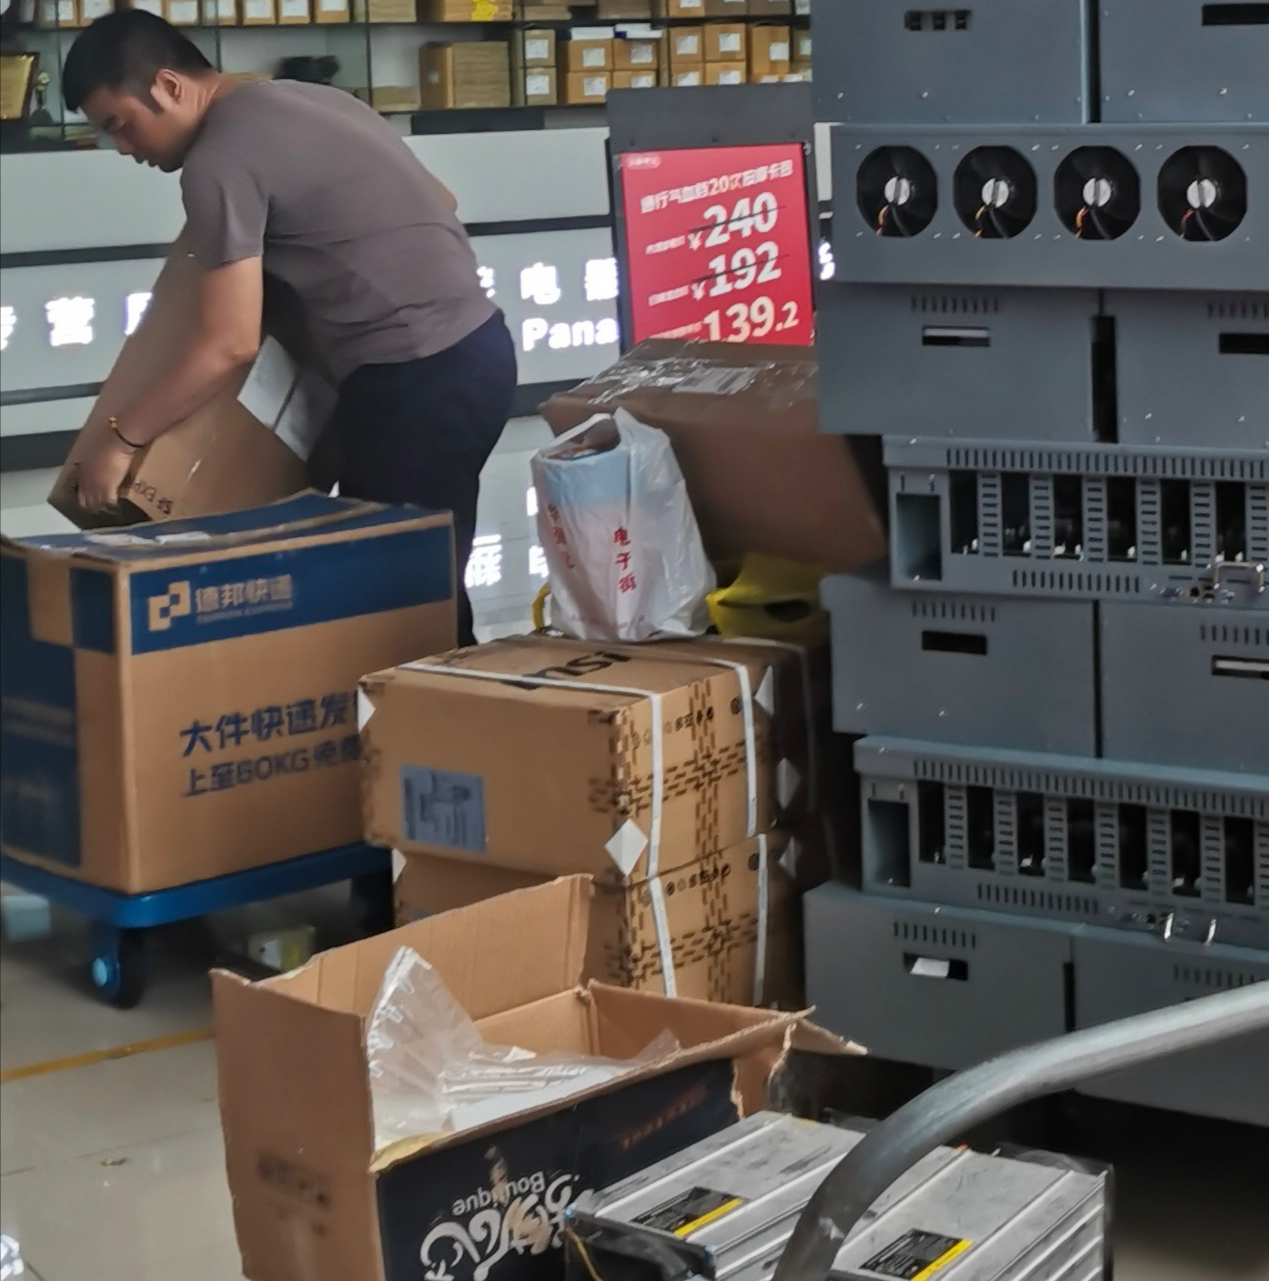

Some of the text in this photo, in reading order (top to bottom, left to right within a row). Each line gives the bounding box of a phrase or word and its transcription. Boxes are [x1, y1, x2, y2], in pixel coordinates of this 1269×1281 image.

[613, 526, 636, 593] 电子街
[180, 689, 358, 757] 大件快递发
